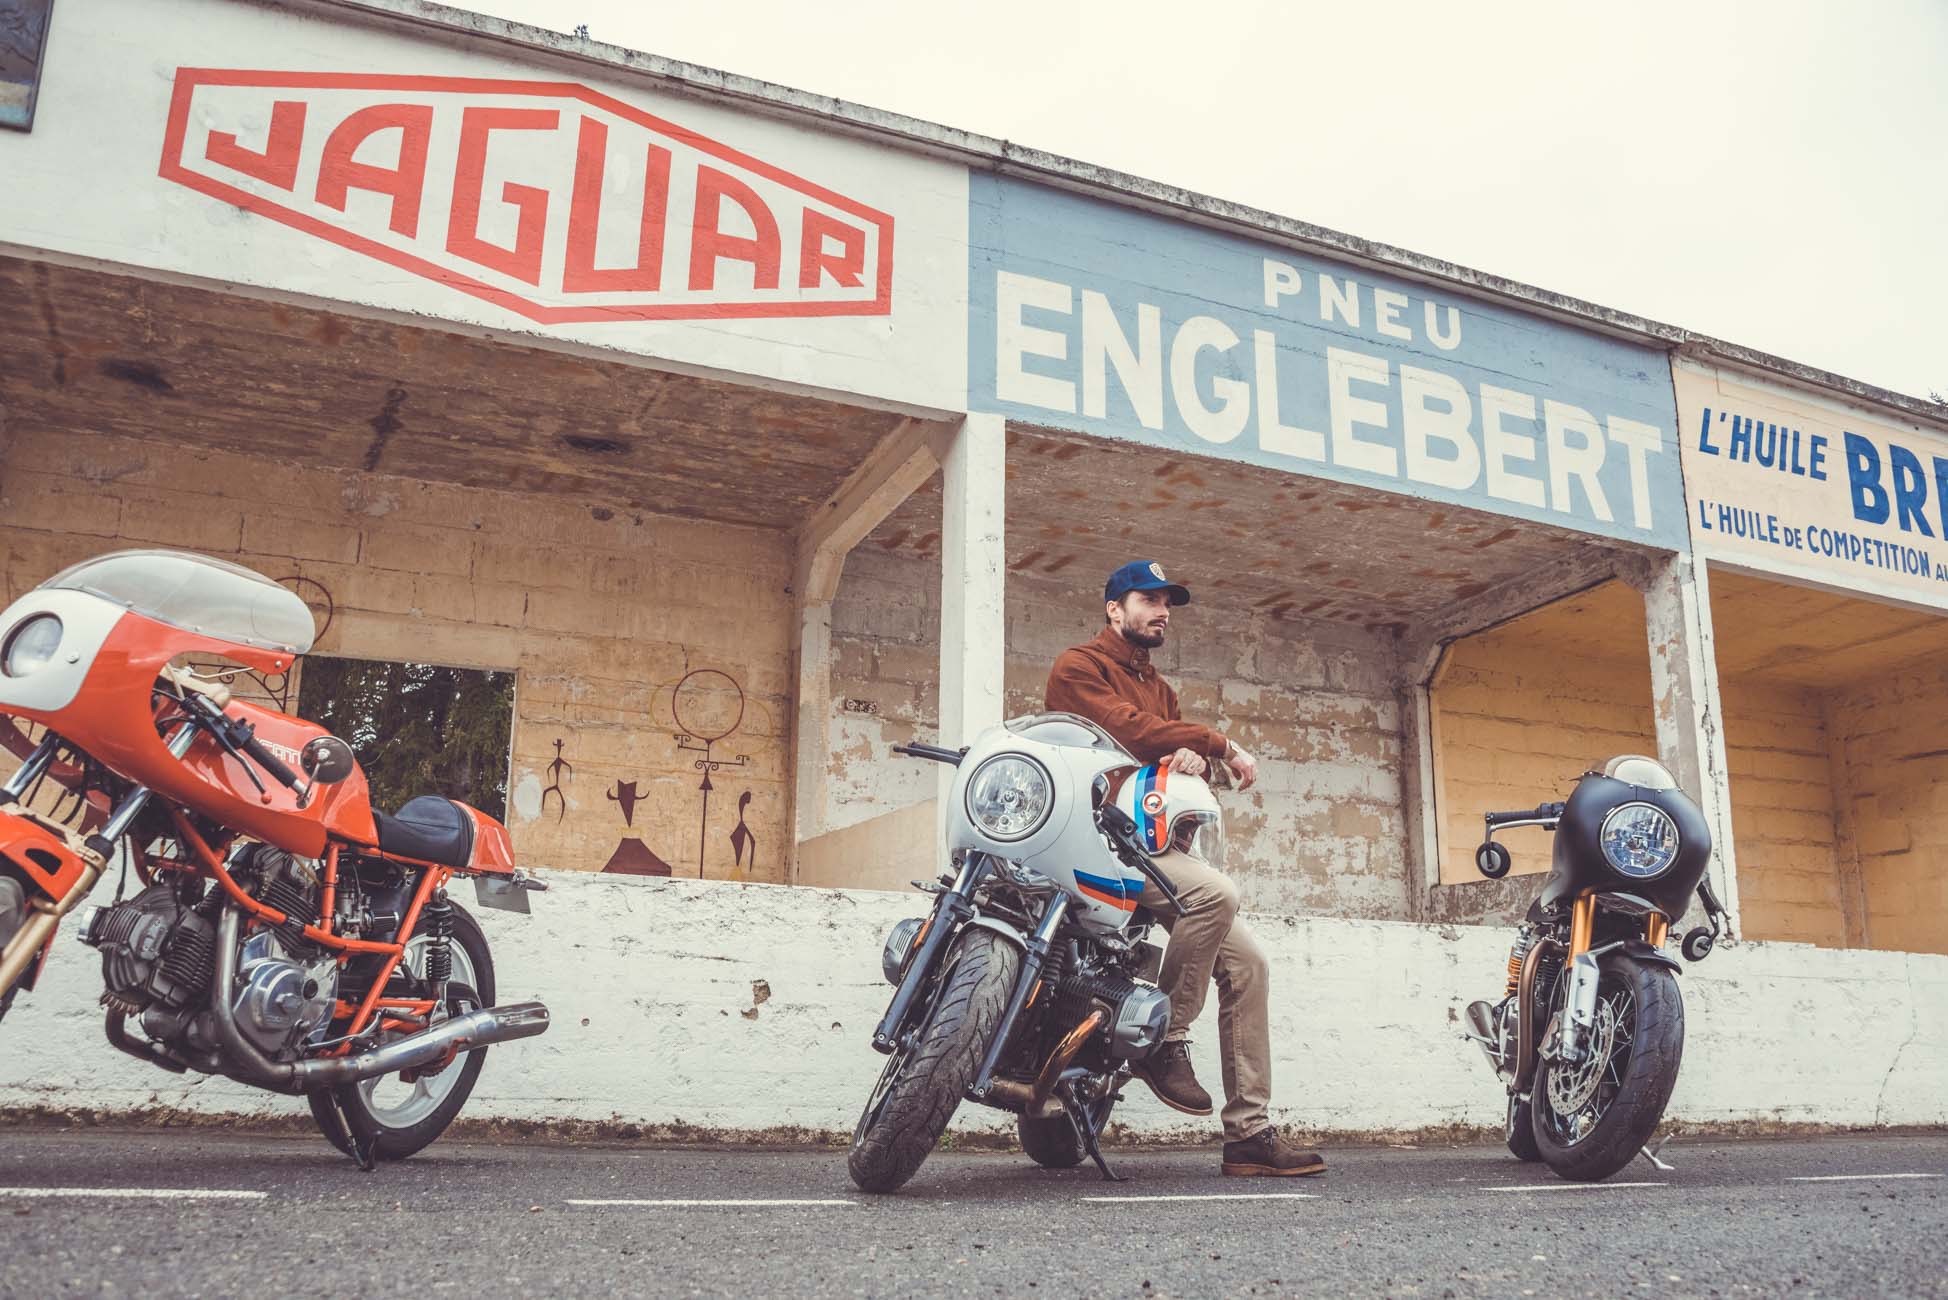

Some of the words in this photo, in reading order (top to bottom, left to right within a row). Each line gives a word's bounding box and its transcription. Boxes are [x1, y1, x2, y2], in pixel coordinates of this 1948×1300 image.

[204, 100, 866, 294] JAGUAR
[1262, 258, 1463, 351] PNEU
[995, 270, 1663, 531] ENGLEBERT
[1698, 407, 1829, 482] L'HUILE
[1699, 499, 1781, 545] L'HUILE
[1783, 526, 1804, 550] DE
[1806, 525, 1932, 579] COMPETITION
